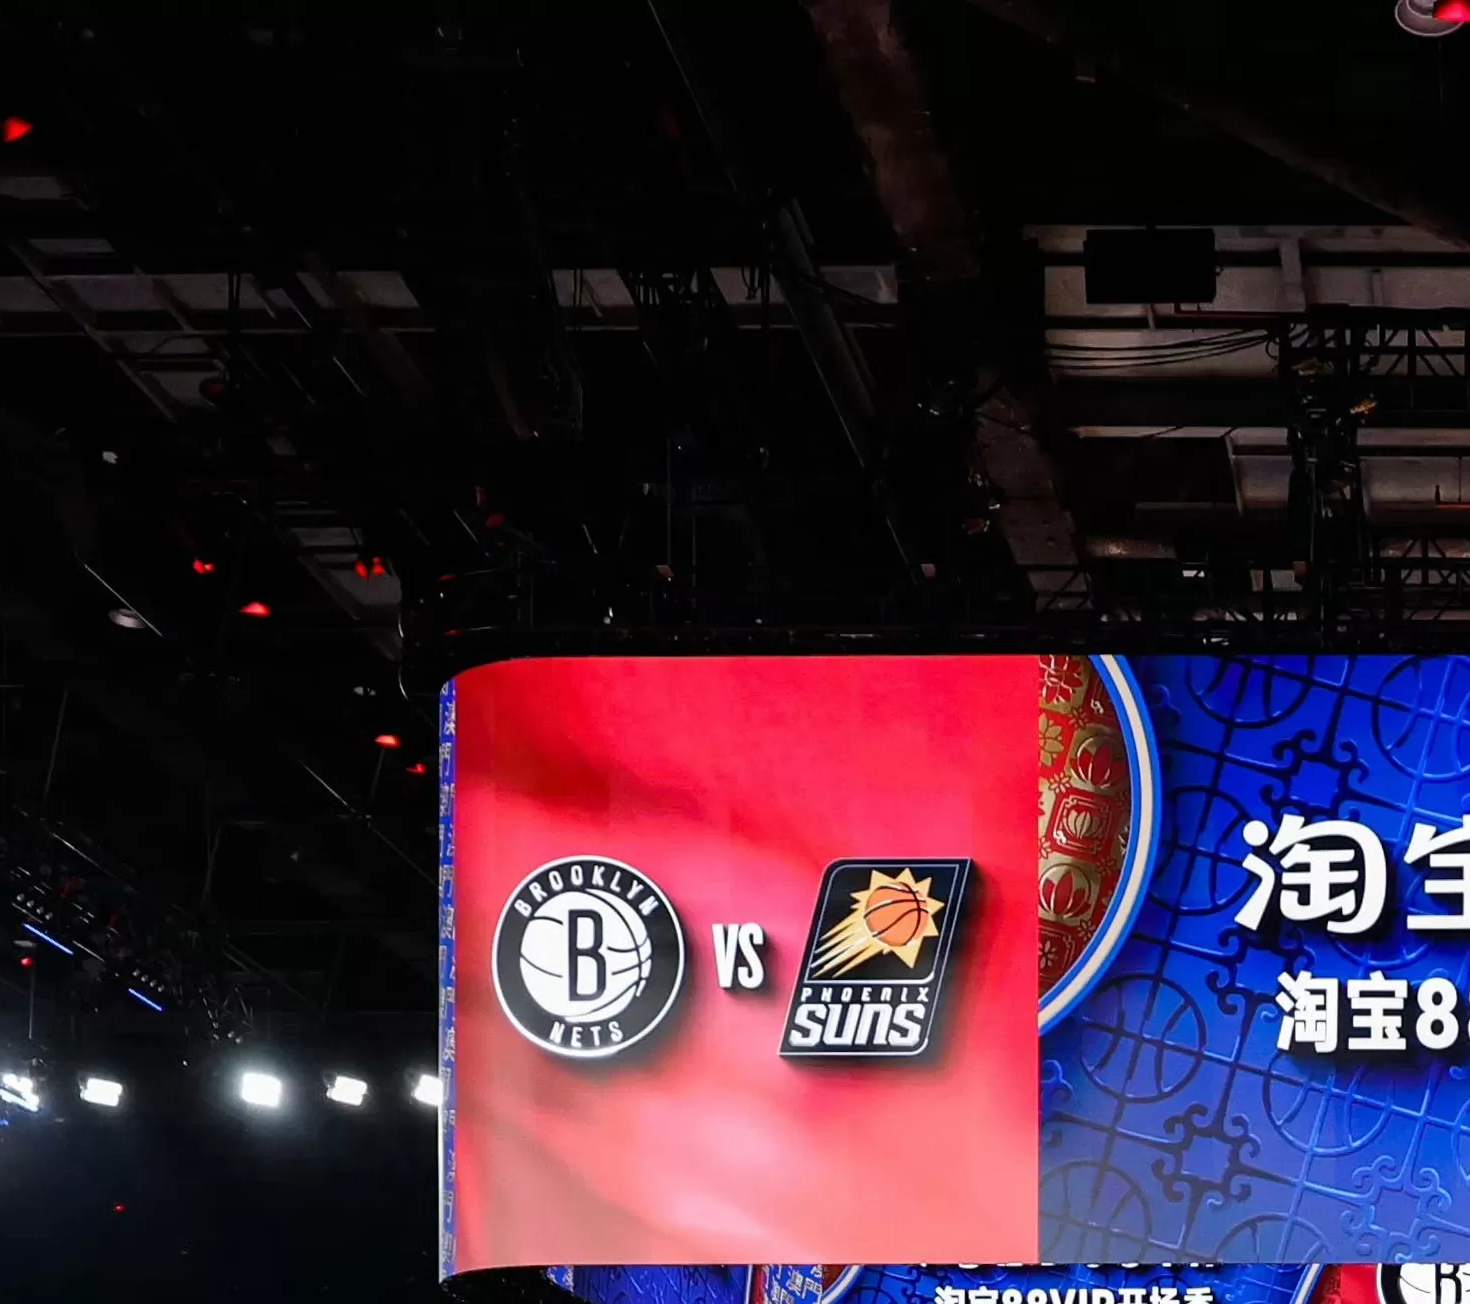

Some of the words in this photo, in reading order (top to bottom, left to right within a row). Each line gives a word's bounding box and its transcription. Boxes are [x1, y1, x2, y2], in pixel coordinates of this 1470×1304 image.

[514, 865, 659, 917] BROOKLYN
[712, 922, 763, 989] VS
[800, 986, 930, 1003] PHOENIX
[550, 1020, 625, 1048] NETS
[789, 1002, 926, 1047] SUNS
